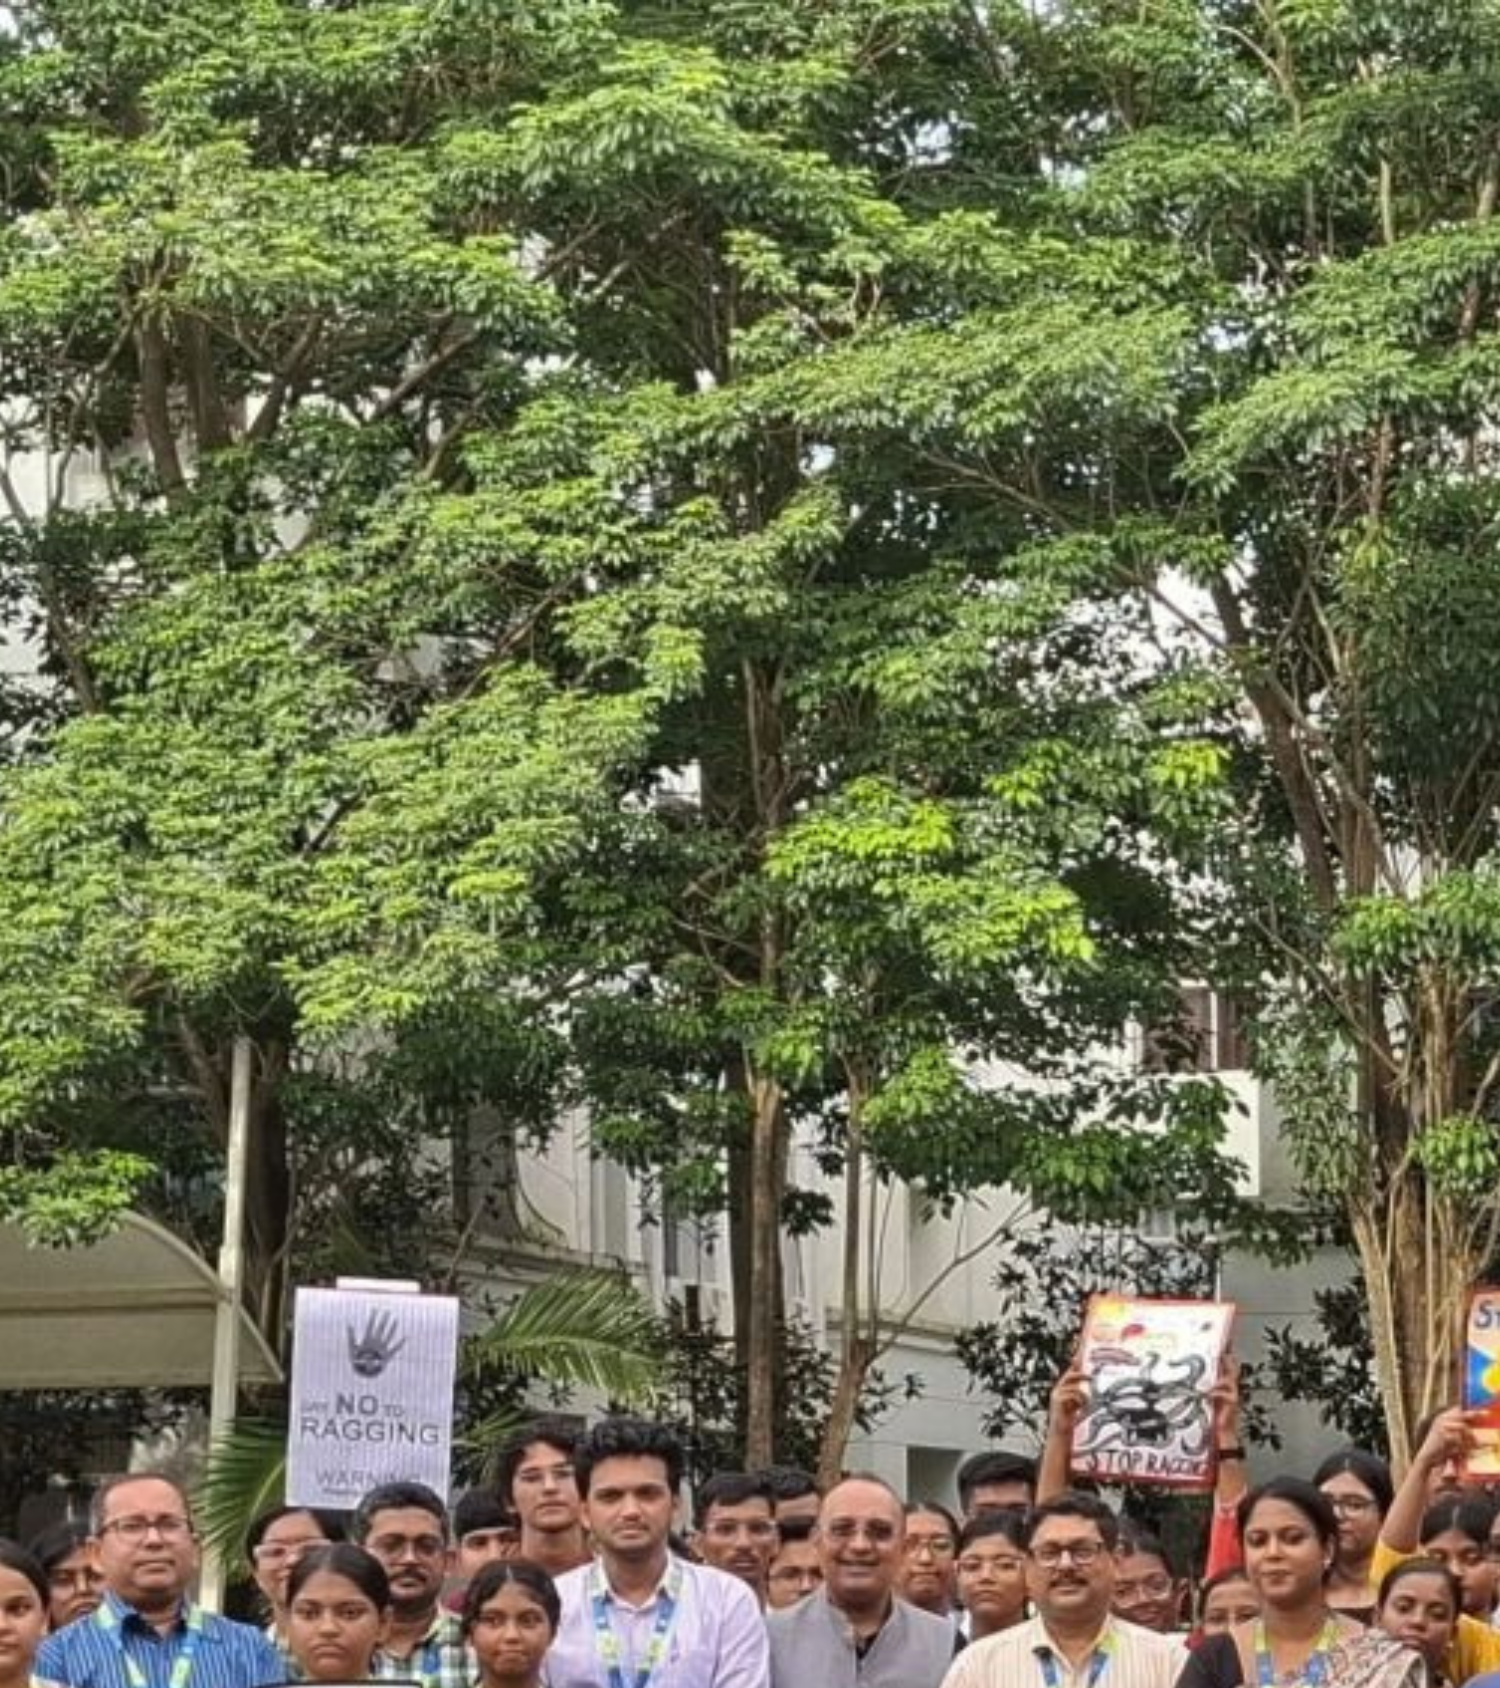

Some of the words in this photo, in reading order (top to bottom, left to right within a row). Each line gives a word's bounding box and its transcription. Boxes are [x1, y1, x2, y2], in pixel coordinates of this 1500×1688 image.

[336, 1394, 379, 1416] NO
[384, 1404, 405, 1417] TO
[300, 1416, 440, 1445] RAGGING
[1086, 1449, 1143, 1474] STOP
